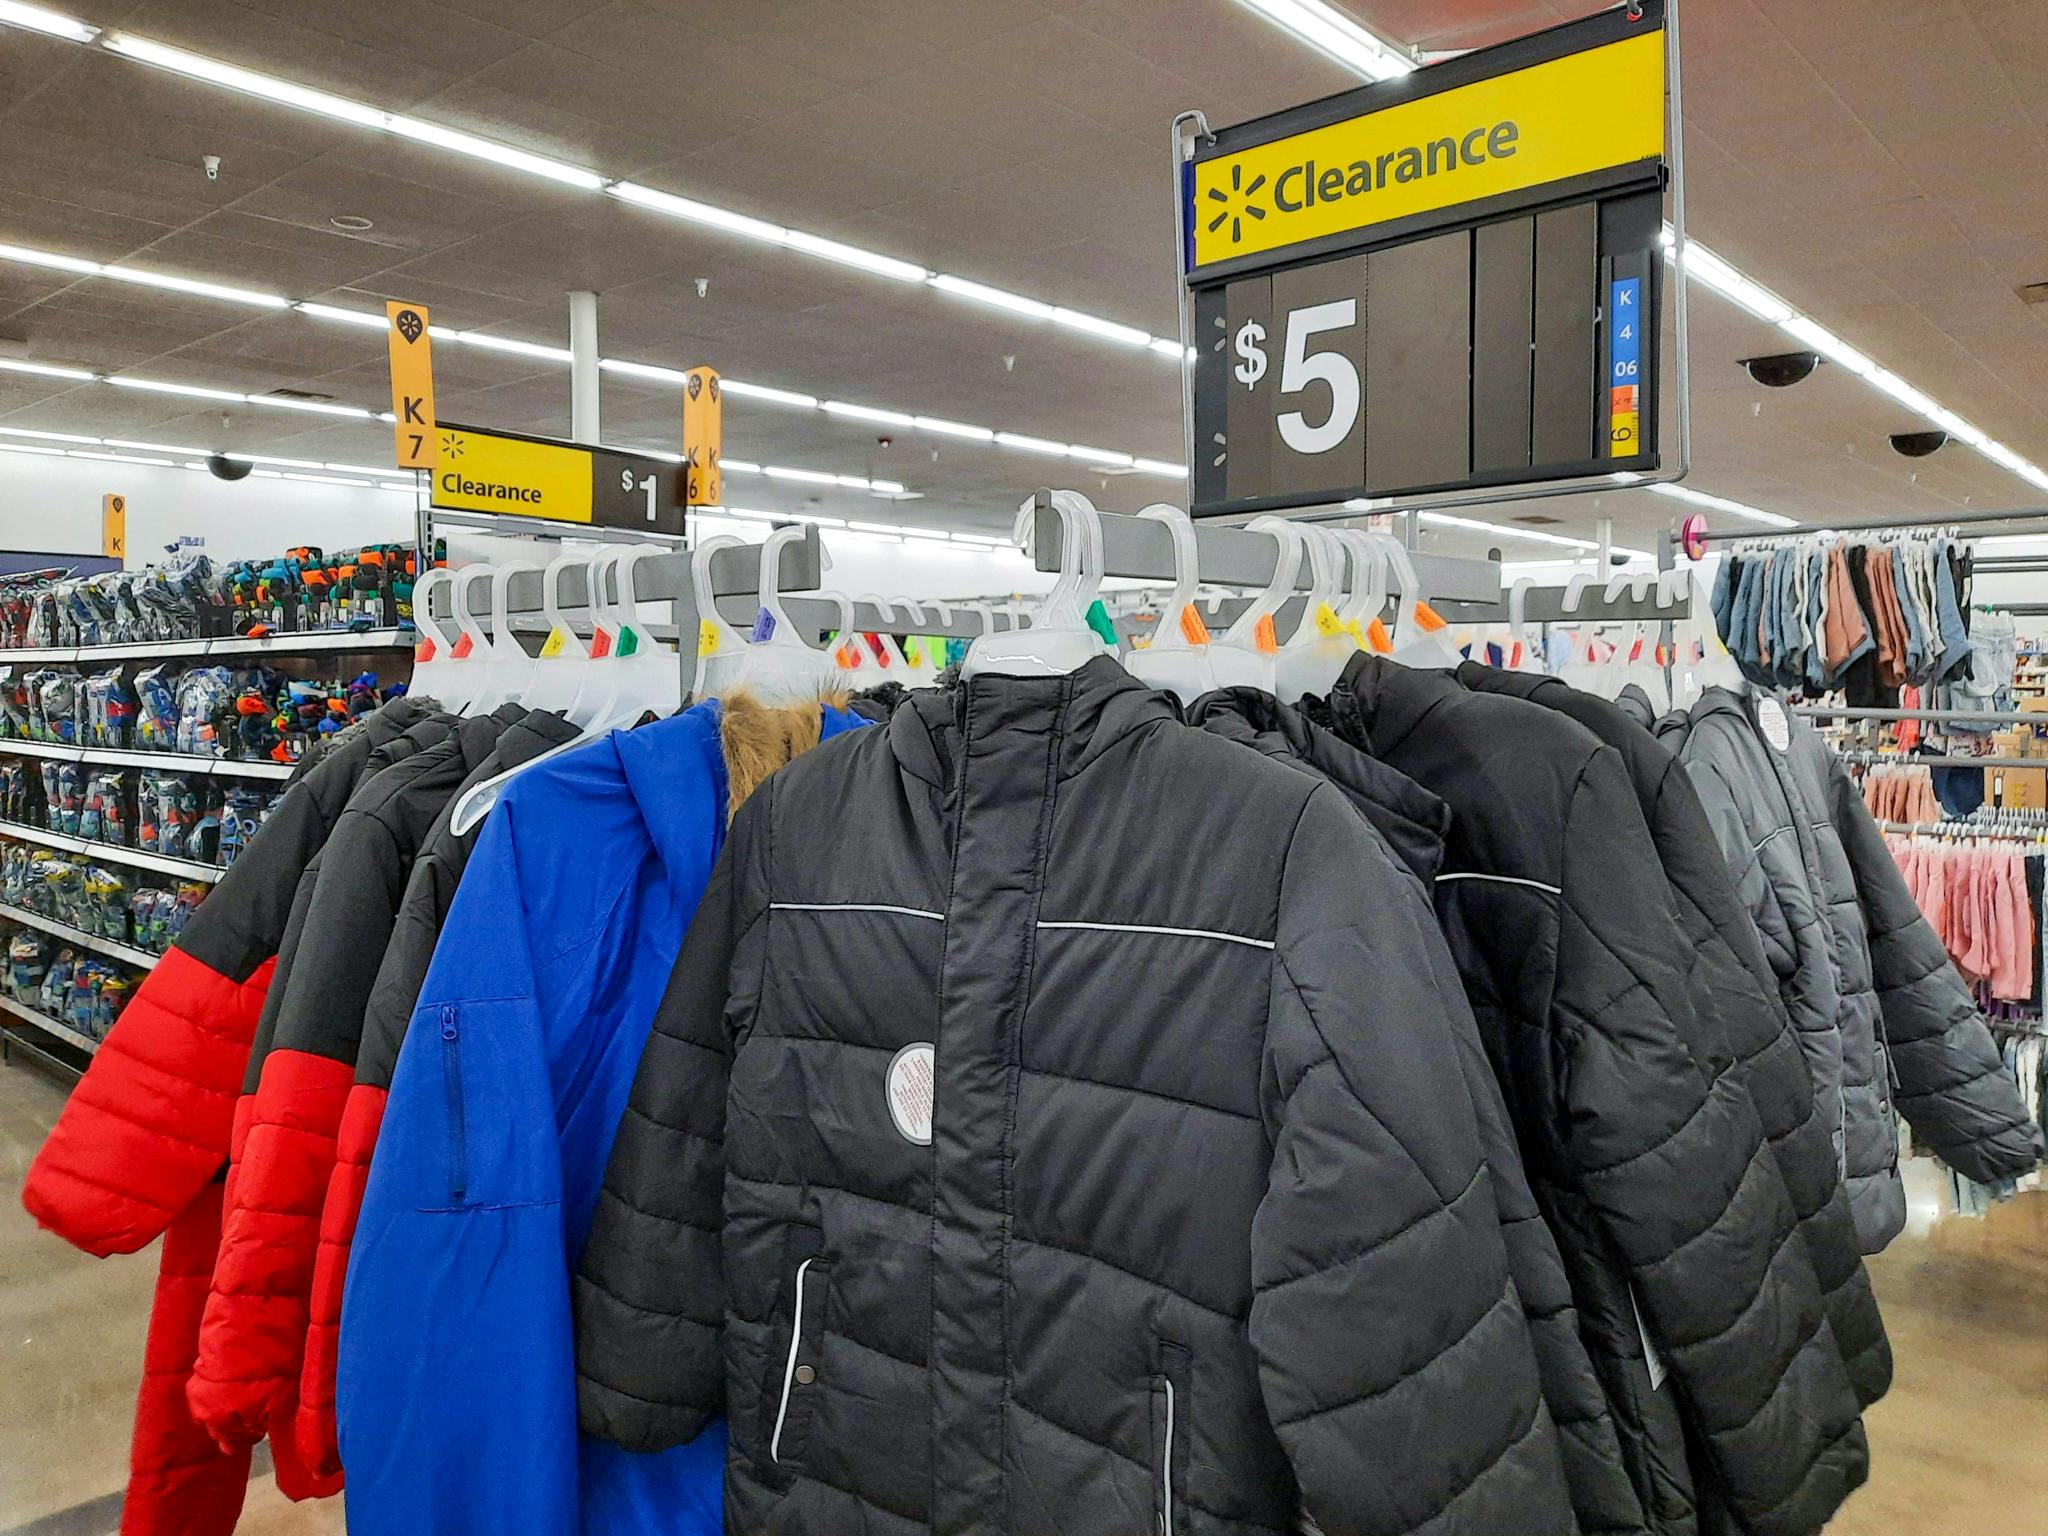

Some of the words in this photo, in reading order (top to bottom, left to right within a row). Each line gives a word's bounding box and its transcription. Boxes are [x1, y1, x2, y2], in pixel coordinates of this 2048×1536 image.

[1274, 119, 1519, 212] Clearance
[1620, 289, 1632, 306] K
[1619, 324, 1632, 340] 4
[1614, 360, 1638, 377] 06
[404, 396, 425, 425] K
[408, 435, 423, 460] 7
[688, 446, 699, 469] K
[709, 447, 717, 471] K
[441, 473, 543, 504] Clearance
[689, 478, 698, 499] 6
[709, 479, 717, 500] 6
[113, 537, 121, 552] K
